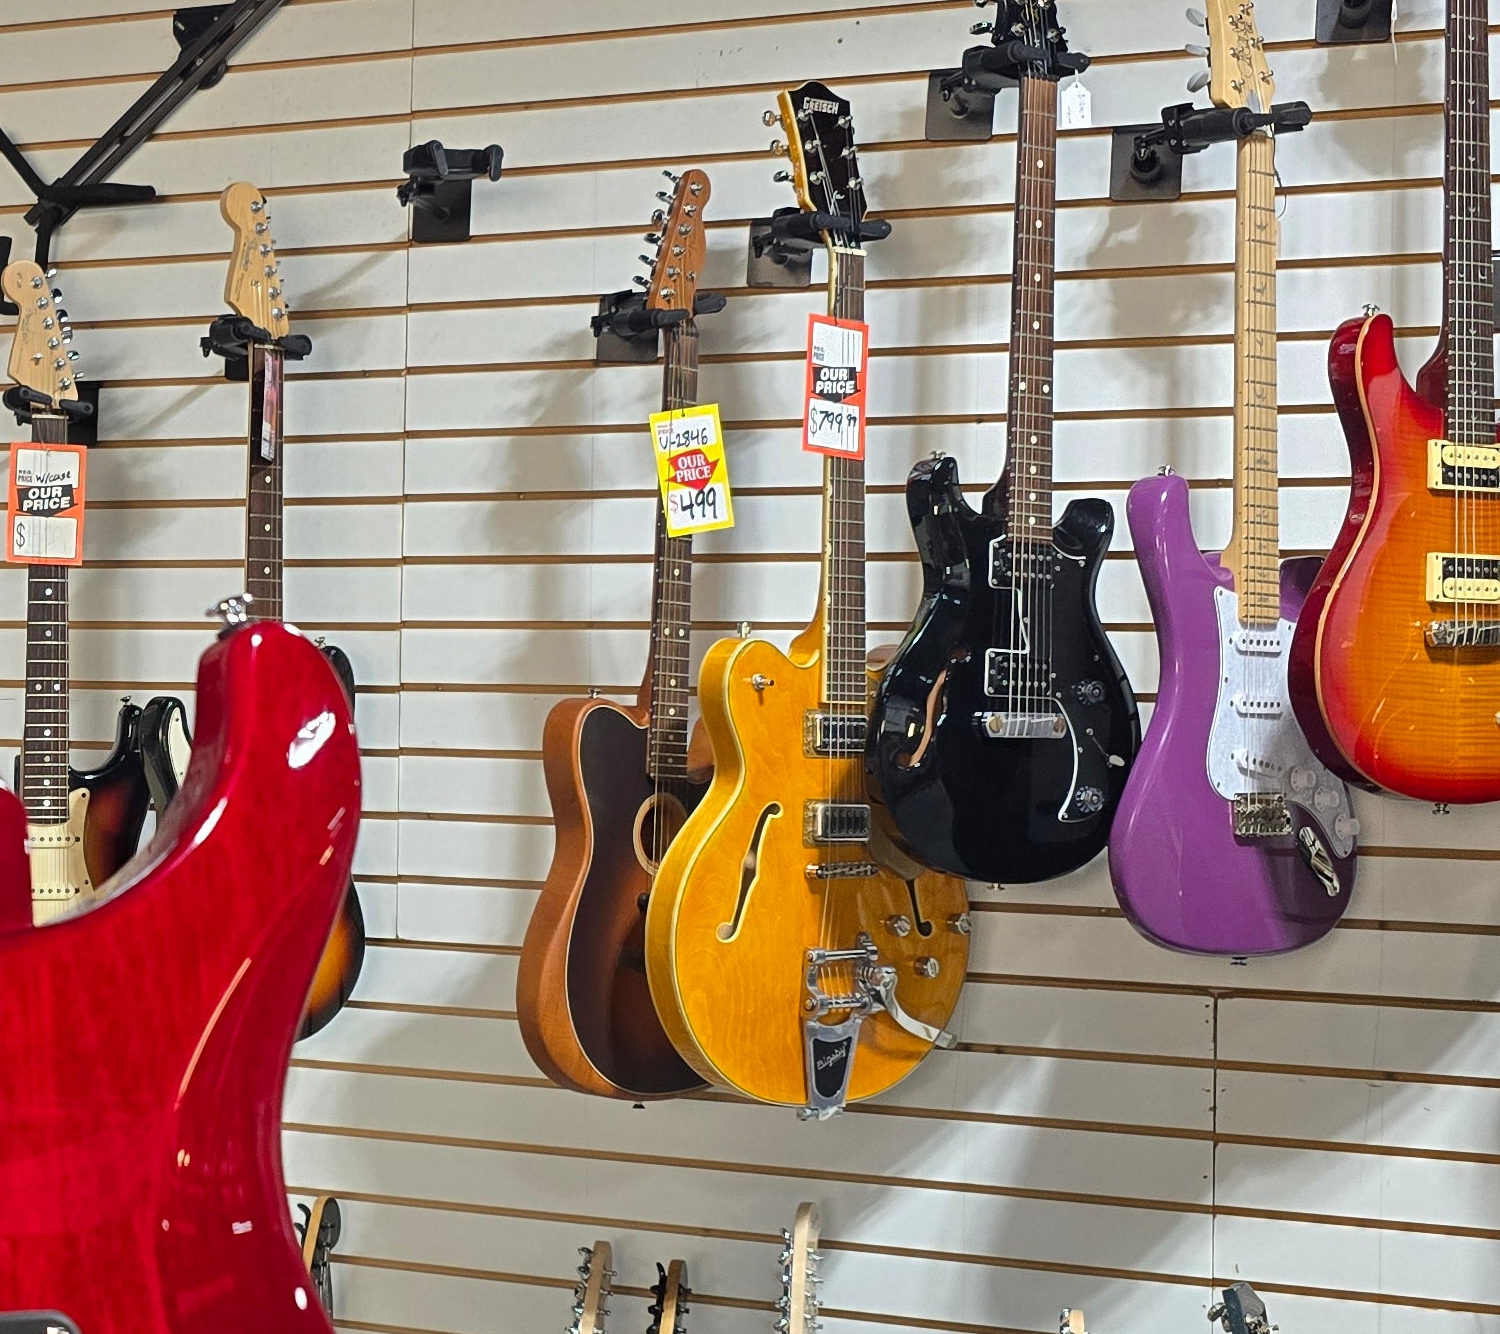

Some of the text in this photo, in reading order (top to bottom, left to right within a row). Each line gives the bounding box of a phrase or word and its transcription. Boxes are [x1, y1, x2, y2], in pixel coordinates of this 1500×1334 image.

[803, 96, 839, 114] GRETSCH
[820, 367, 848, 381] OUR
[815, 380, 856, 394] PRICE
[677, 453, 706, 470] OUR
[675, 465, 712, 483] PRICE
[28, 486, 63, 500] OUR
[22, 497, 70, 511] PRICE
[669, 487, 718, 520] $499
[816, 1044, 847, 1071] Bigsby
